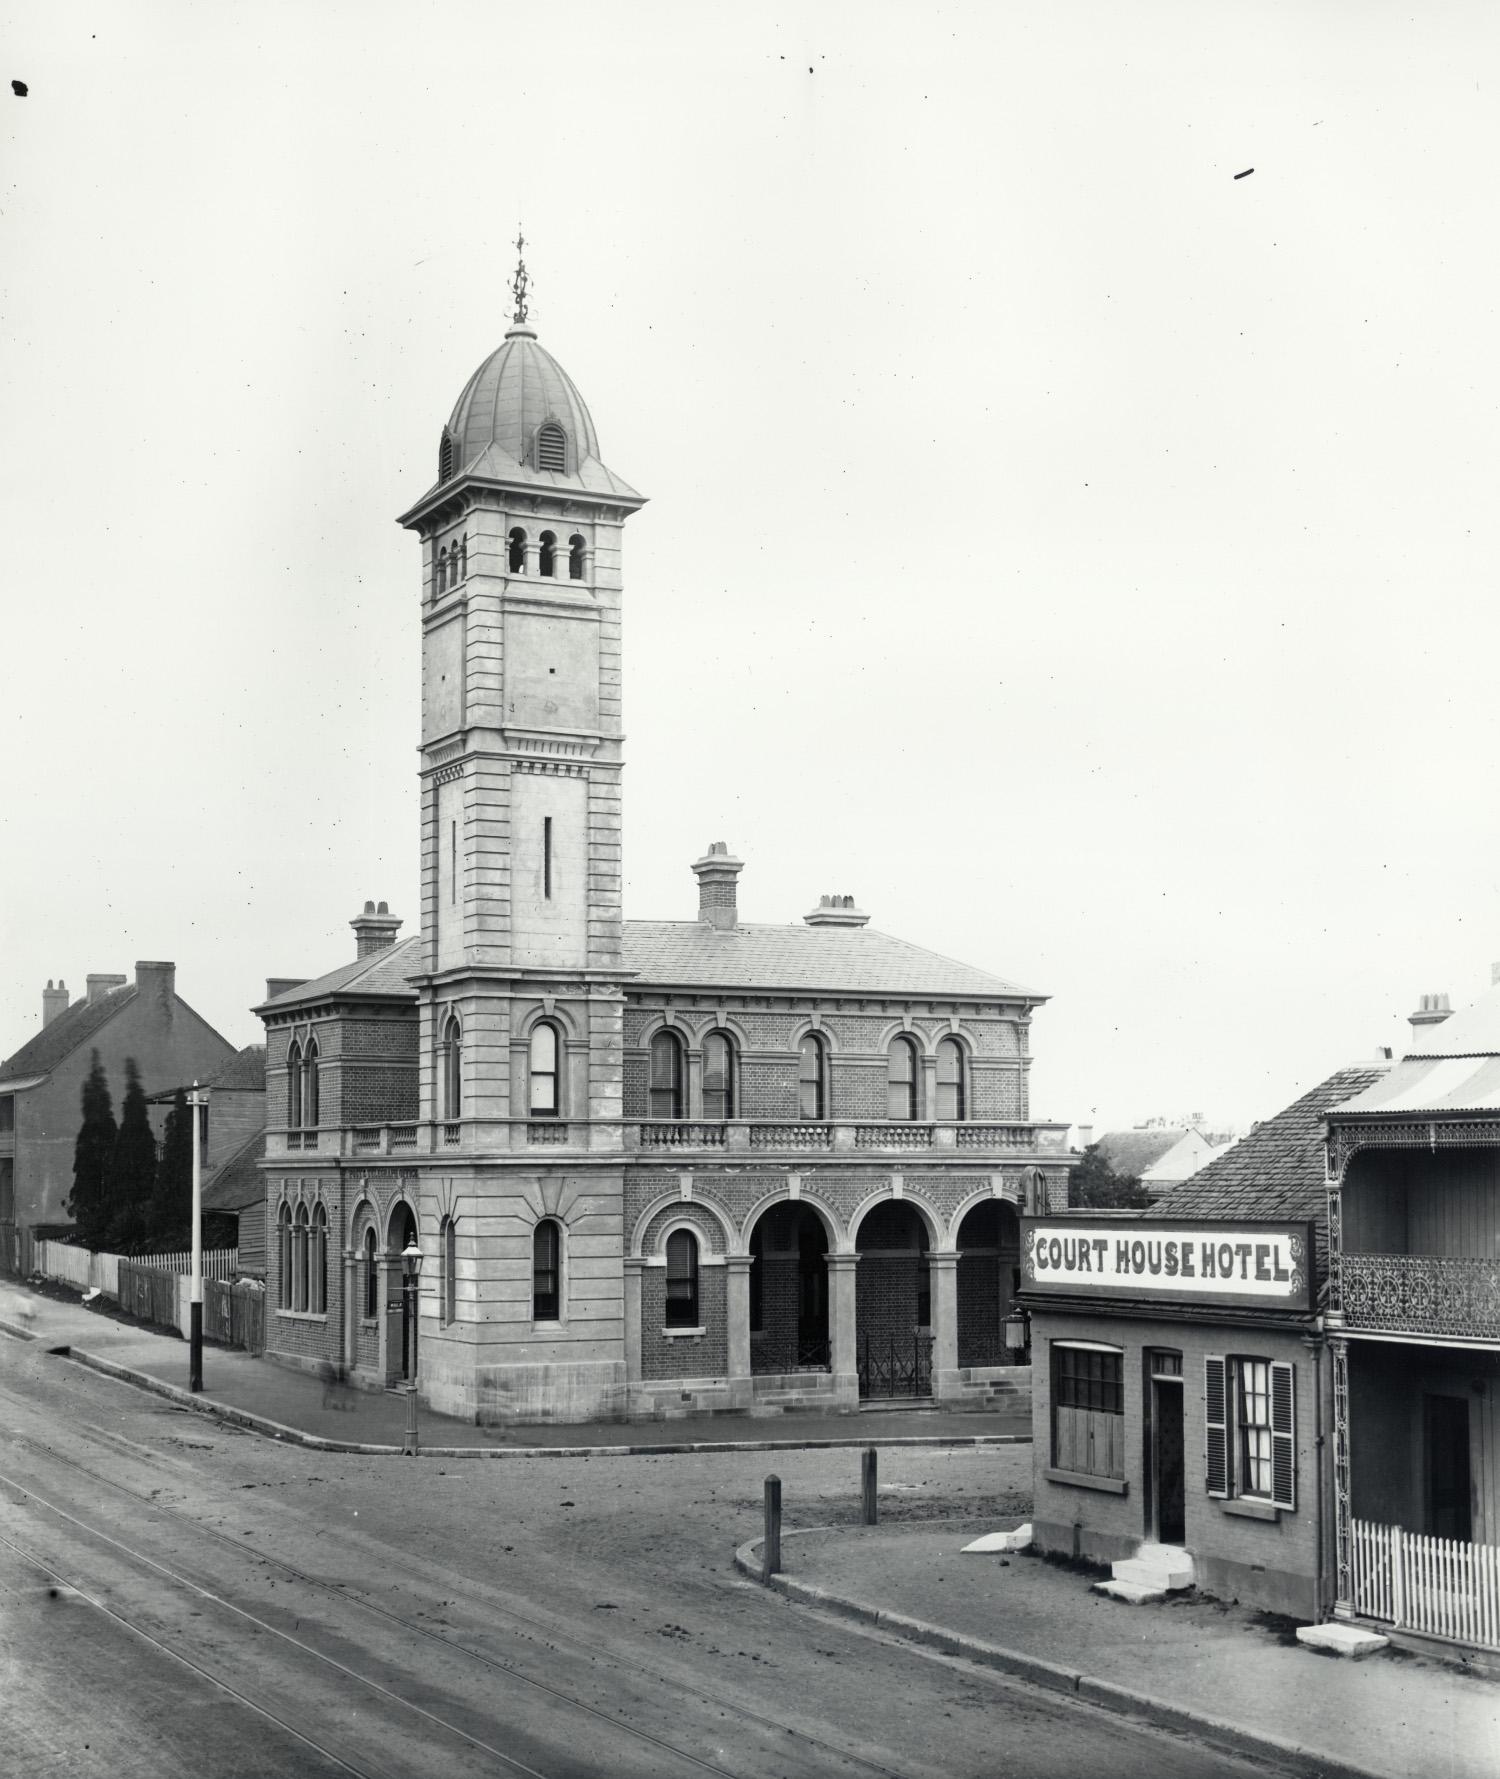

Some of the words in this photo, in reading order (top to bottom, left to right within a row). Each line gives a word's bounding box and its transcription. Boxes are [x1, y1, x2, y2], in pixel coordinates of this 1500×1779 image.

[1036, 1237, 1108, 1272] COURT
[1115, 1240, 1196, 1277] HOUSE
[1201, 1242, 1290, 1282] HOTEL
